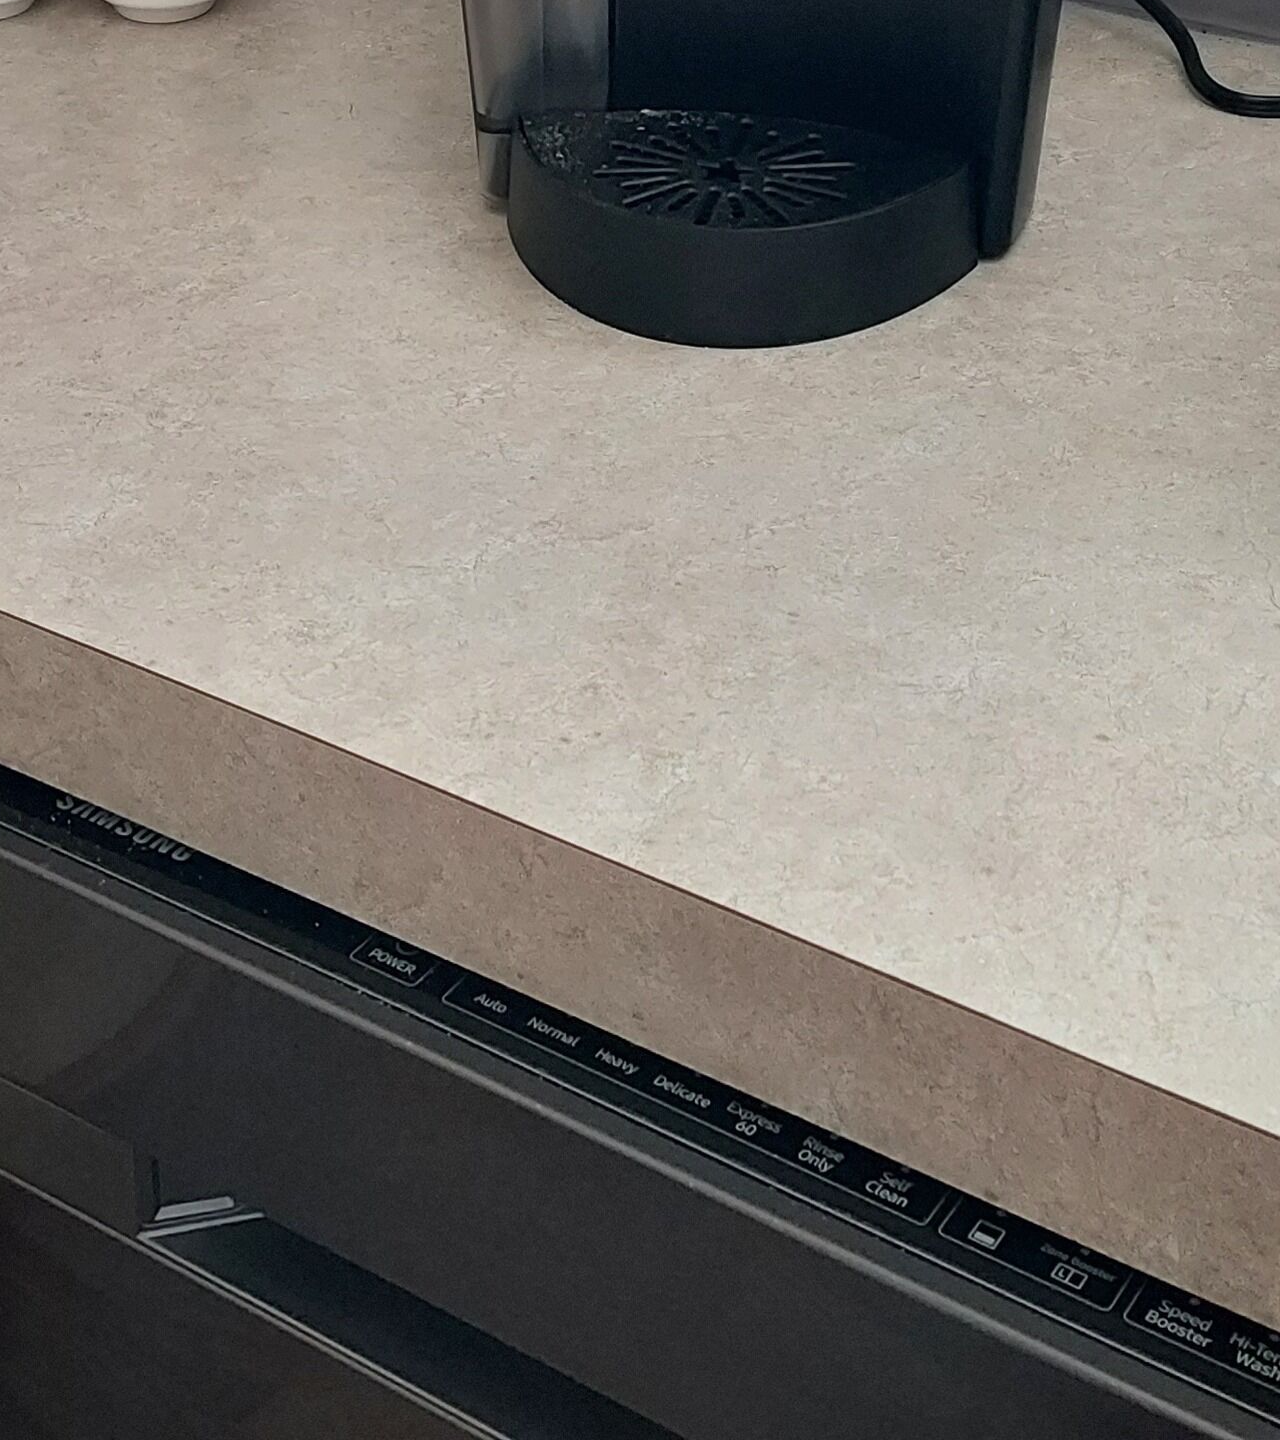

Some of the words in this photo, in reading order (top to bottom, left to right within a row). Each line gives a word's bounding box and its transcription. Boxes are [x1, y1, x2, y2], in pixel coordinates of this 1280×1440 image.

[368, 947, 417, 976] POWER
[473, 992, 507, 1014] Auto
[526, 1016, 581, 1048] Normal
[594, 1048, 639, 1076] Heavy
[653, 1073, 712, 1109] Delicate
[726, 1100, 783, 1134] Express
[734, 1121, 757, 1137] 60
[798, 1149, 834, 1173] Only
[803, 1135, 845, 1164] Rinse
[865, 1179, 909, 1208] Clean
[879, 1171, 914, 1193] Self
[1144, 1309, 1214, 1349] Booster
[1158, 1298, 1213, 1332] Speed
